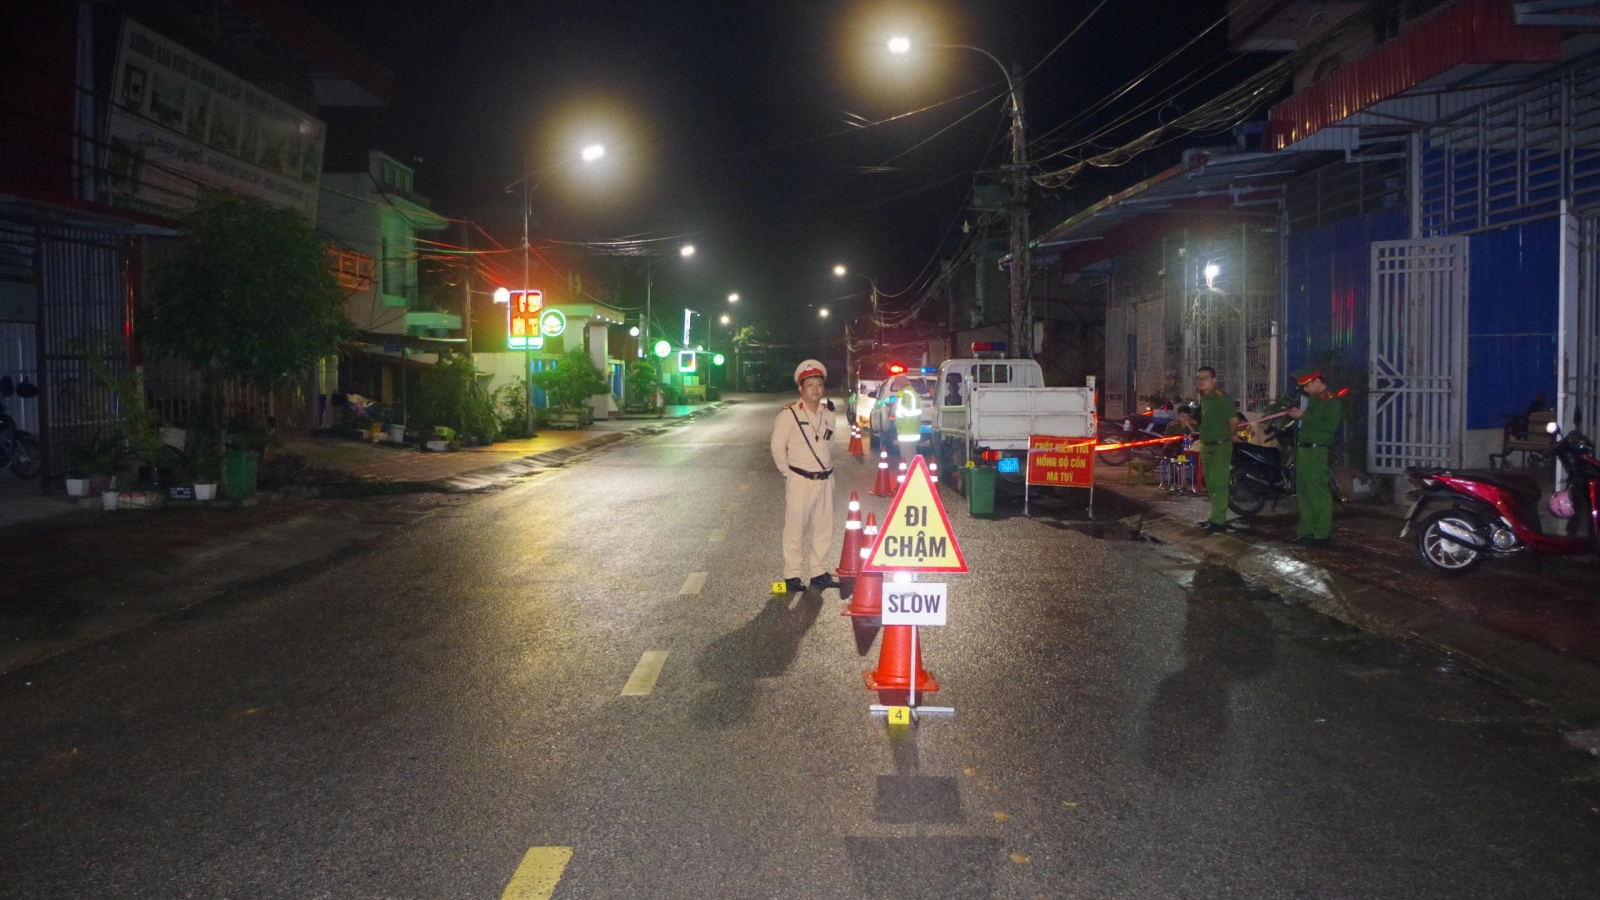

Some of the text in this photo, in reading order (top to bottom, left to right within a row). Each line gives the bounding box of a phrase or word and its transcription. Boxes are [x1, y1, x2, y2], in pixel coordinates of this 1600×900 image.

[1076, 444, 1089, 454] TRA
[1058, 456, 1069, 470] ĐỘ
[1046, 471, 1059, 481] MA
[904, 505, 927, 527] ĐI
[884, 531, 947, 562] CHẬM
[888, 594, 941, 613] SLOW
[894, 709, 903, 720] 4
